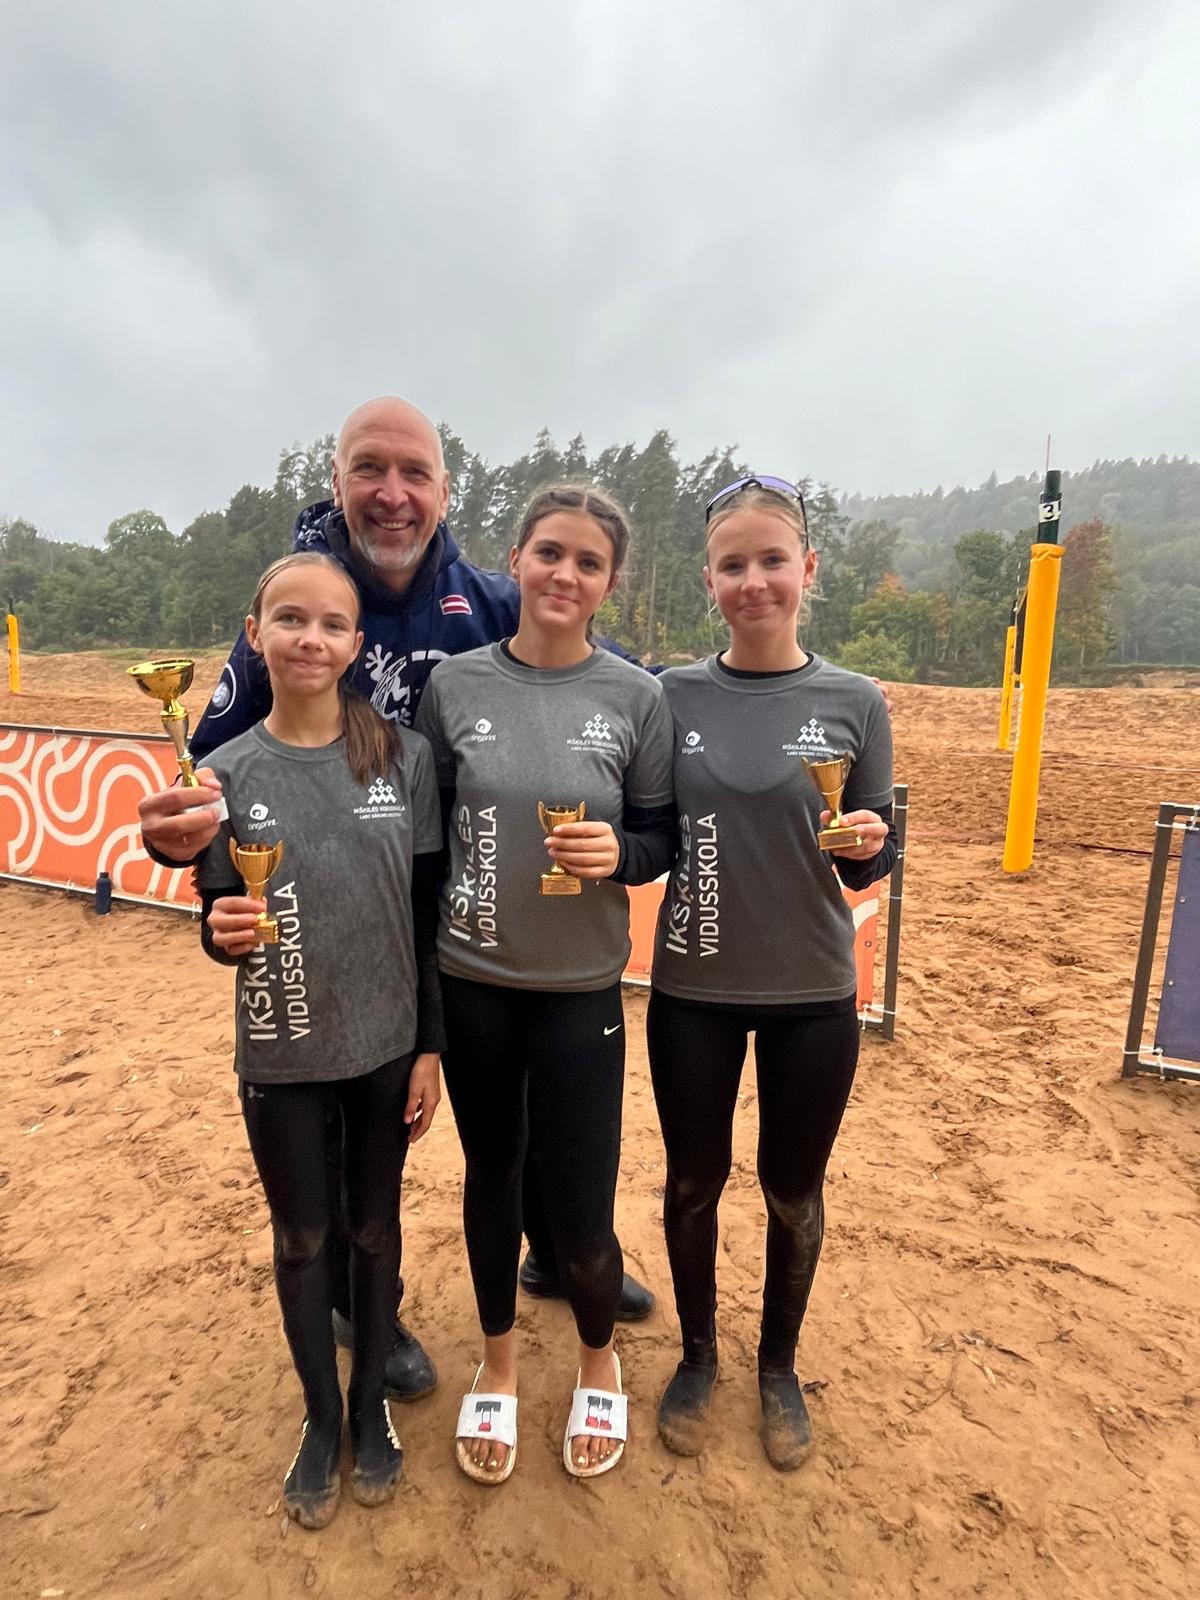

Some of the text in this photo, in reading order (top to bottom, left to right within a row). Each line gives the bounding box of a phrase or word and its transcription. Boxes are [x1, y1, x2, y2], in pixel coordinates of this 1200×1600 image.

[1043, 503, 1055, 520] 3
[477, 805, 499, 948] VIDUSSKOLA
[665, 813, 694, 955] IKŠĶILES
[697, 812, 719, 958] VIDUSSKOLA
[241, 942, 278, 1041] IKŠĶIL
